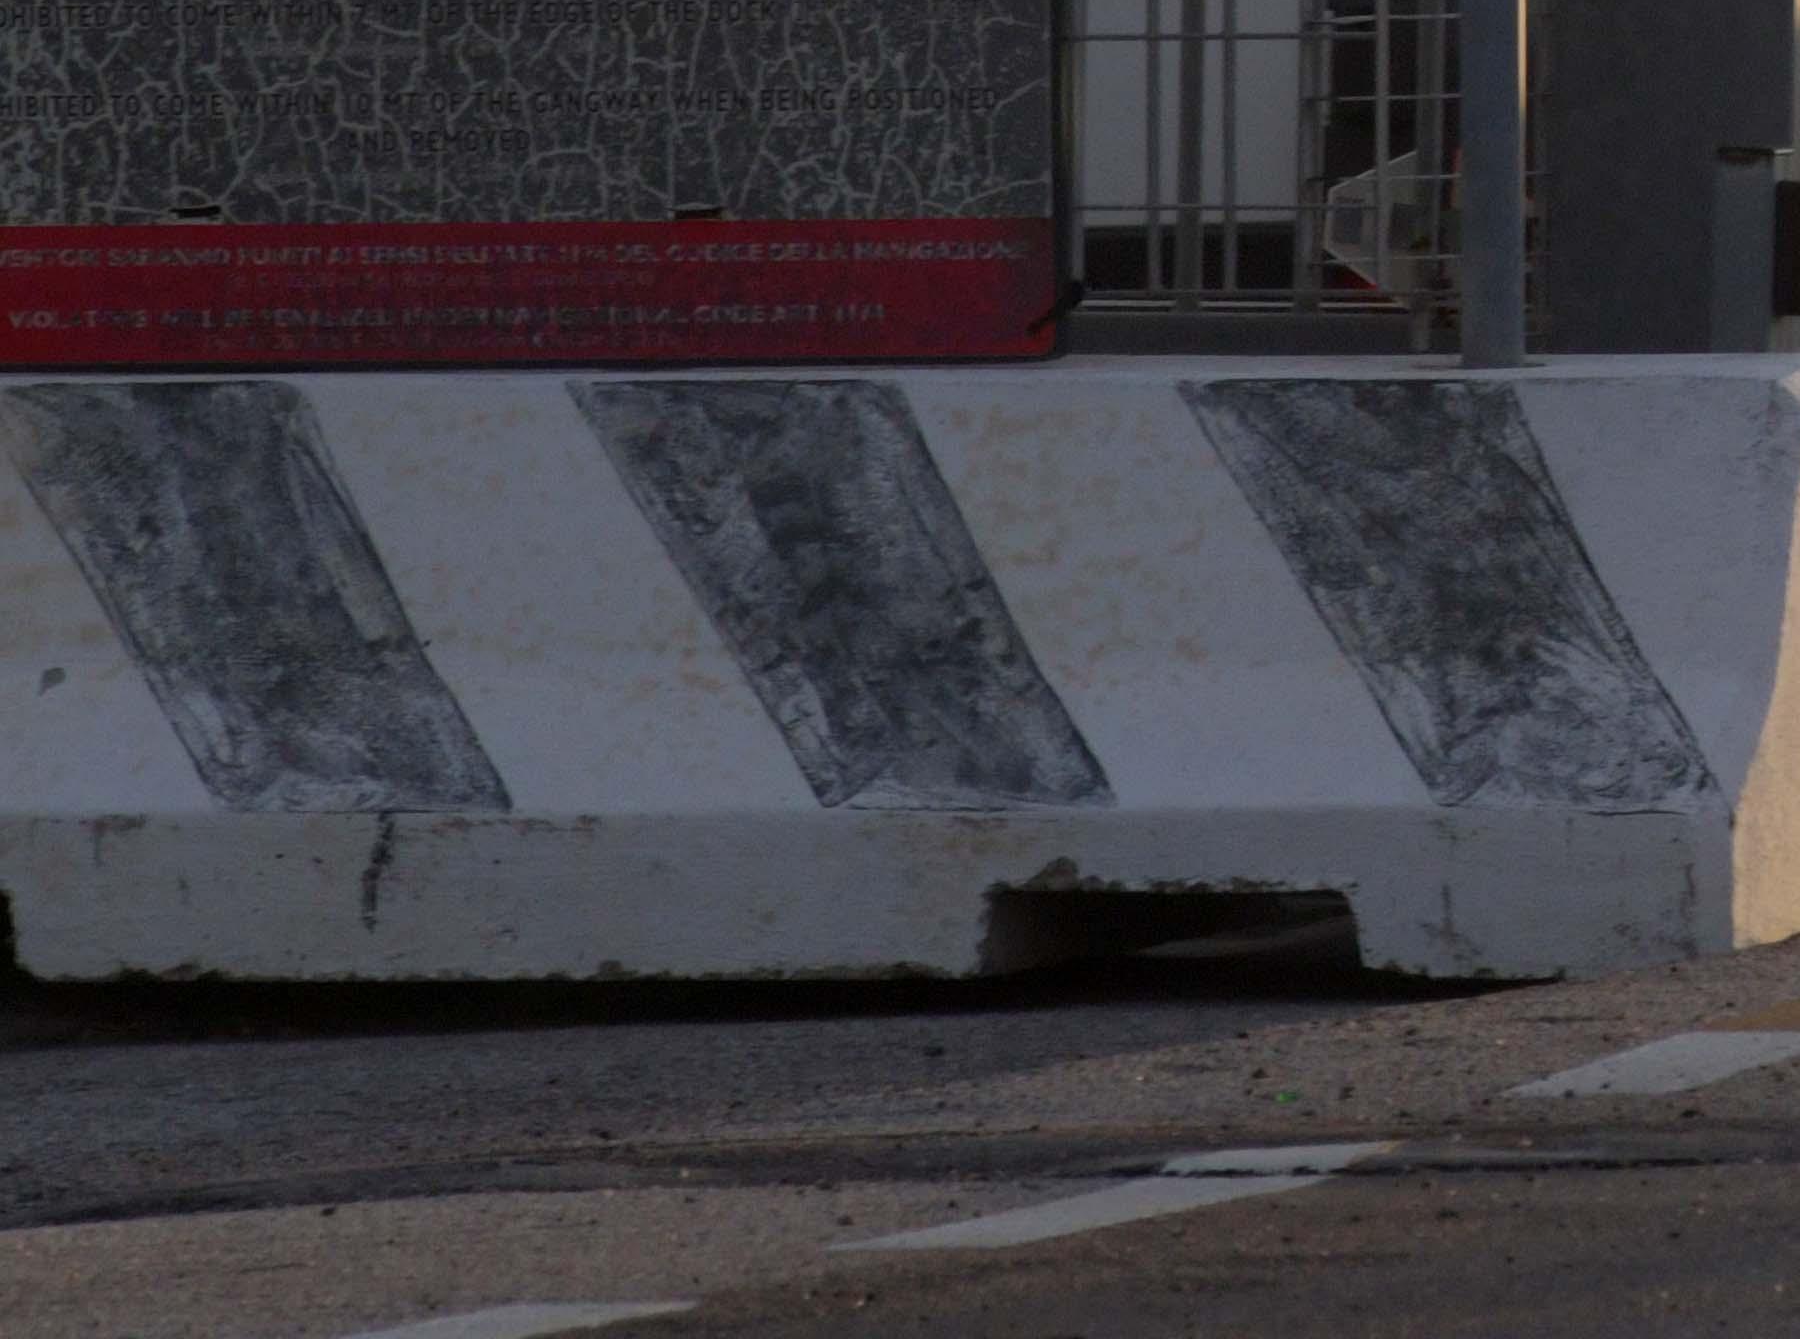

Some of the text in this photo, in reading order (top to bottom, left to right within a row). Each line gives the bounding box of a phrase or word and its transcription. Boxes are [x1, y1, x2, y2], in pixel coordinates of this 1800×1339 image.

[118, 5, 153, 29] TO
[163, 4, 236, 28] COME
[250, 3, 343, 28] WITHIN
[379, 2, 416, 26] MT
[428, 1, 462, 25] OF
[472, 0, 521, 25] THE
[529, 0, 600, 25] EDGE
[607, 0, 643, 24] OF
[653, 0, 698, 24] THE
[110, 94, 143, 118] TO
[152, 94, 226, 118] COME
[236, 93, 333, 117] WITHIN
[382, 92, 417, 116] MT
[429, 92, 462, 116] OF
[470, 90, 521, 116] THE
[532, 90, 660, 115] GANGWAY
[673, 89, 750, 114] WHEN
[758, 89, 838, 113] BEING
[848, 87, 999, 113] POSITIONED
[346, 128, 531, 155] AND REMOVED
